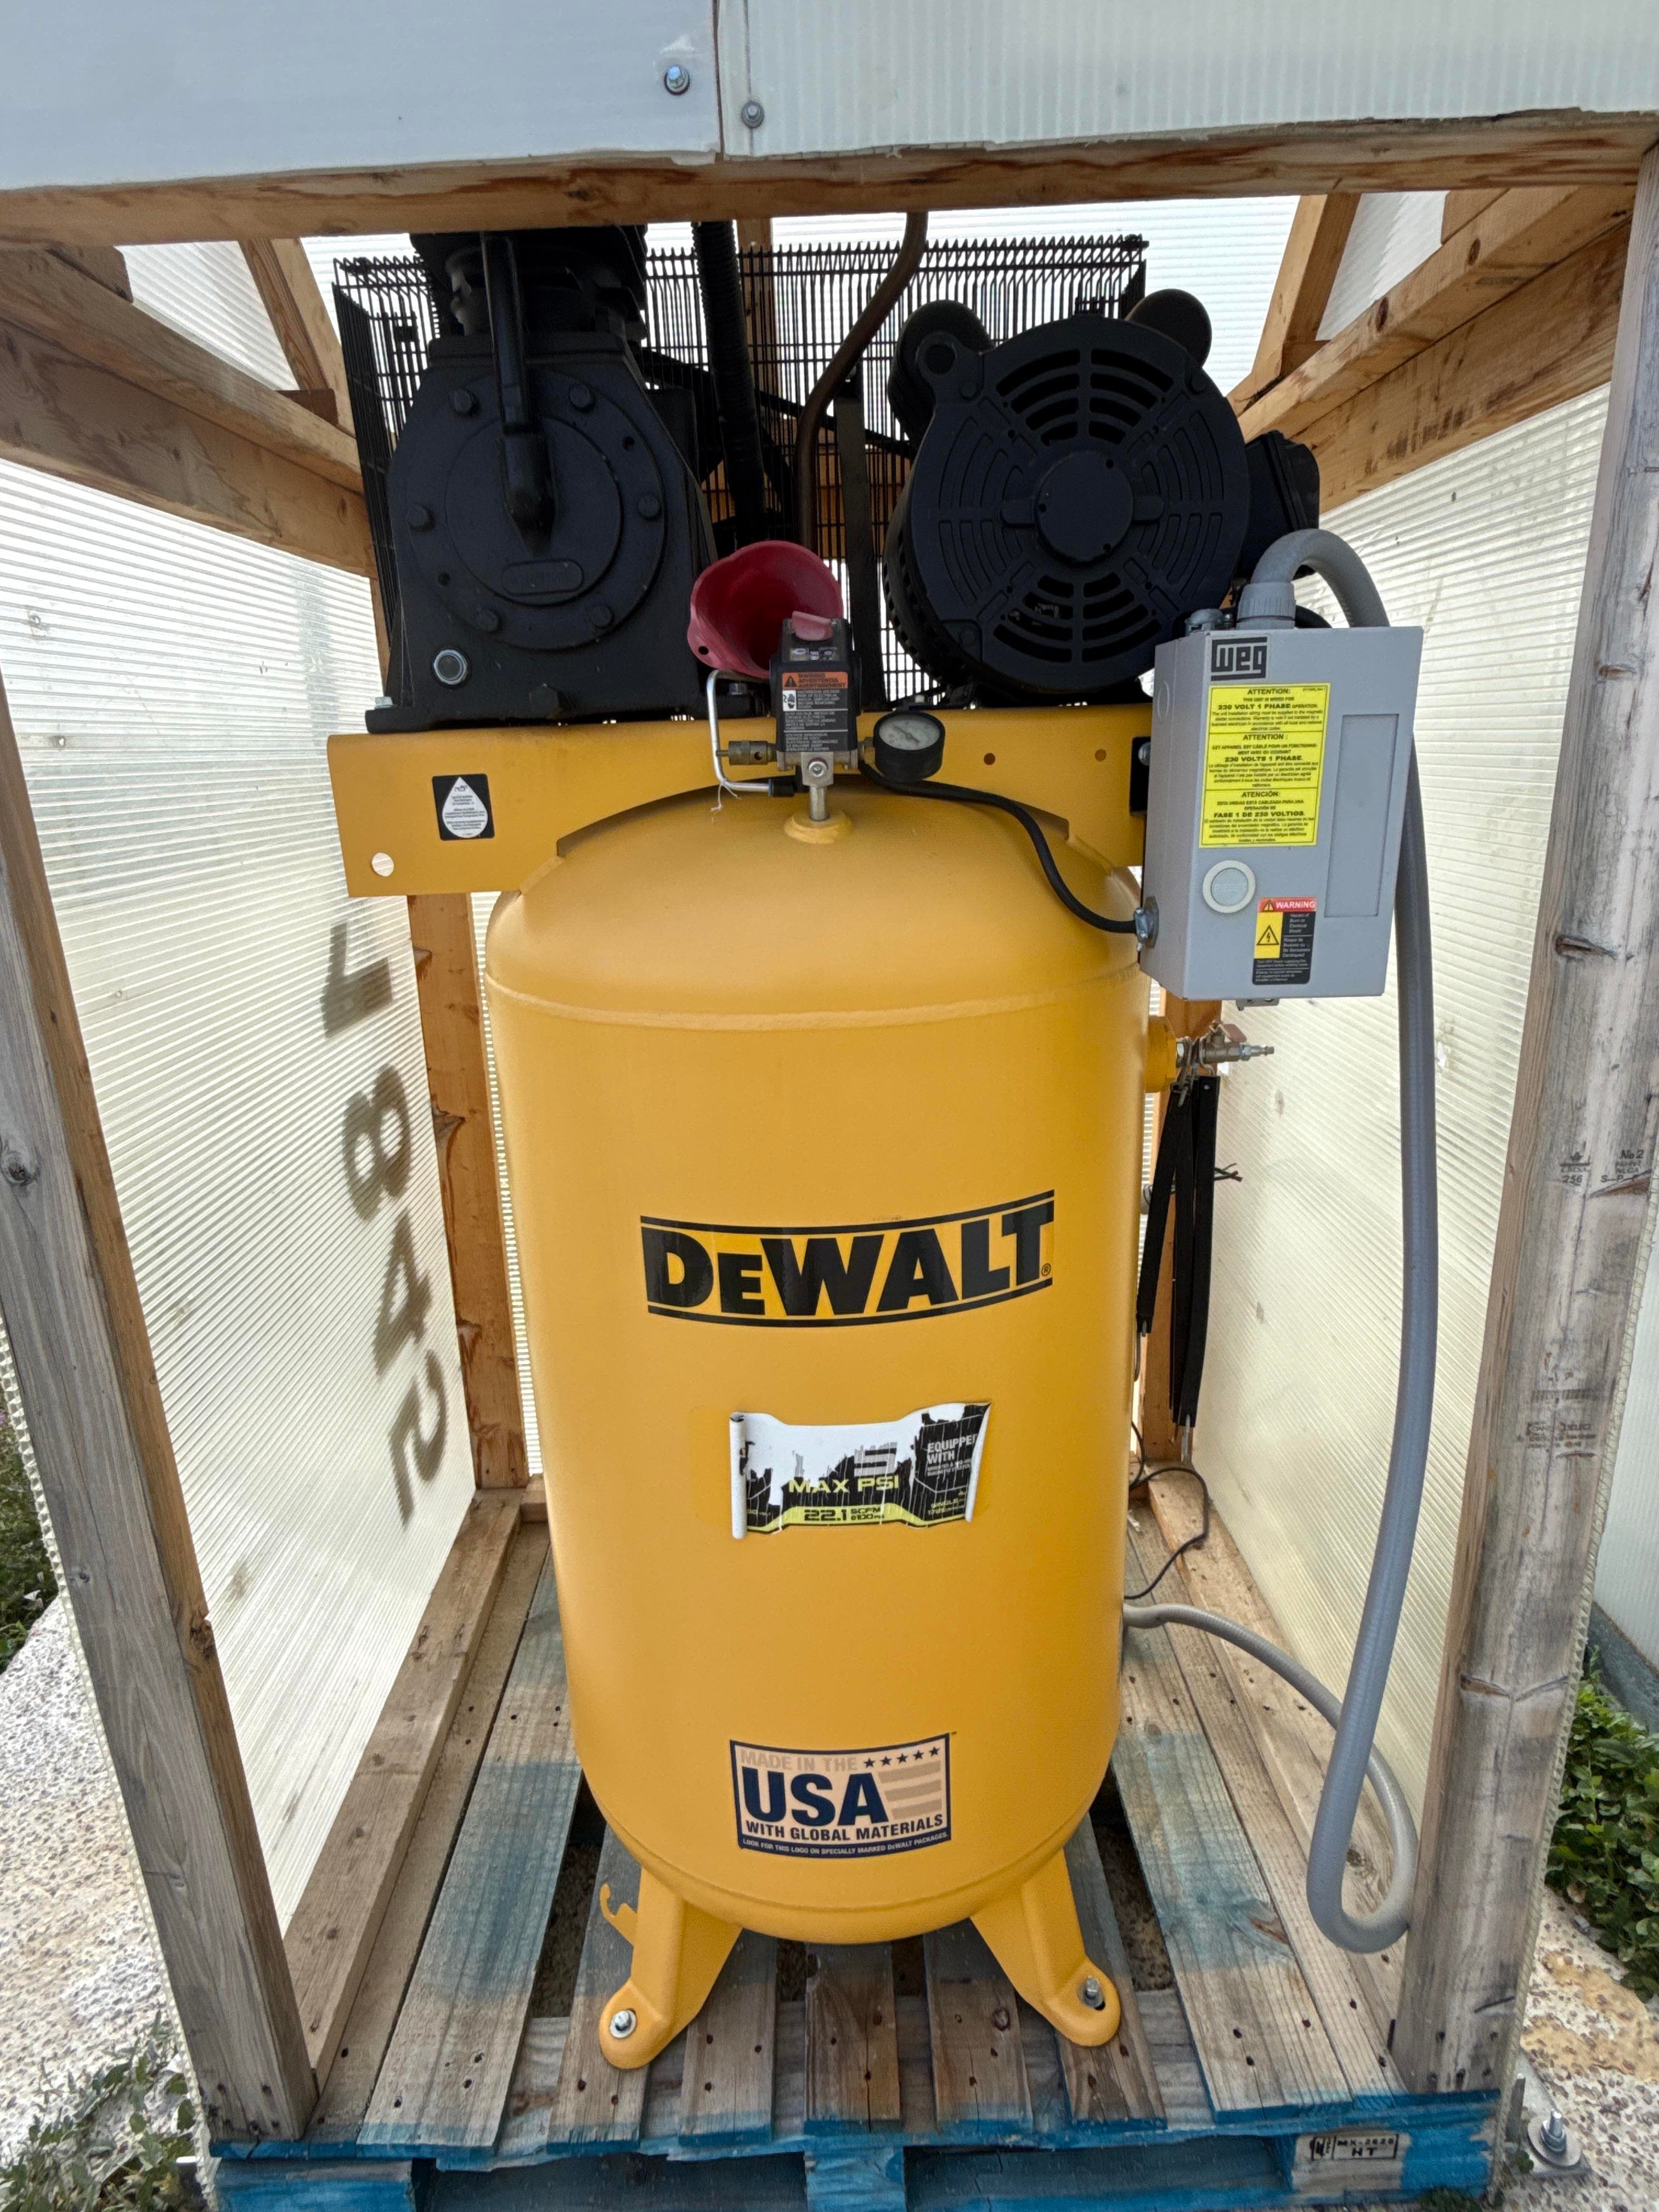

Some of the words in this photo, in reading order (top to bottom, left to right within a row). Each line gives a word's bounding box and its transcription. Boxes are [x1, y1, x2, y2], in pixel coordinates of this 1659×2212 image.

[928, 1450, 955, 1464] WITH
[788, 1479, 850, 1493] MAX
[857, 1475, 899, 1492] PSI
[804, 1509, 847, 1521] 22.1
[740, 1750, 791, 1770] MADE
[797, 1757, 815, 1771] IN
[823, 1757, 859, 1772] THE
[742, 1766, 889, 1826] USA
[746, 1821, 785, 1838] WITH
[791, 1826, 850, 1841] GLOBAL
[855, 1814, 943, 1840] MATERIALS
[857, 1845, 885, 1853] MARKED
[1352, 2147, 1378, 2156] HT
